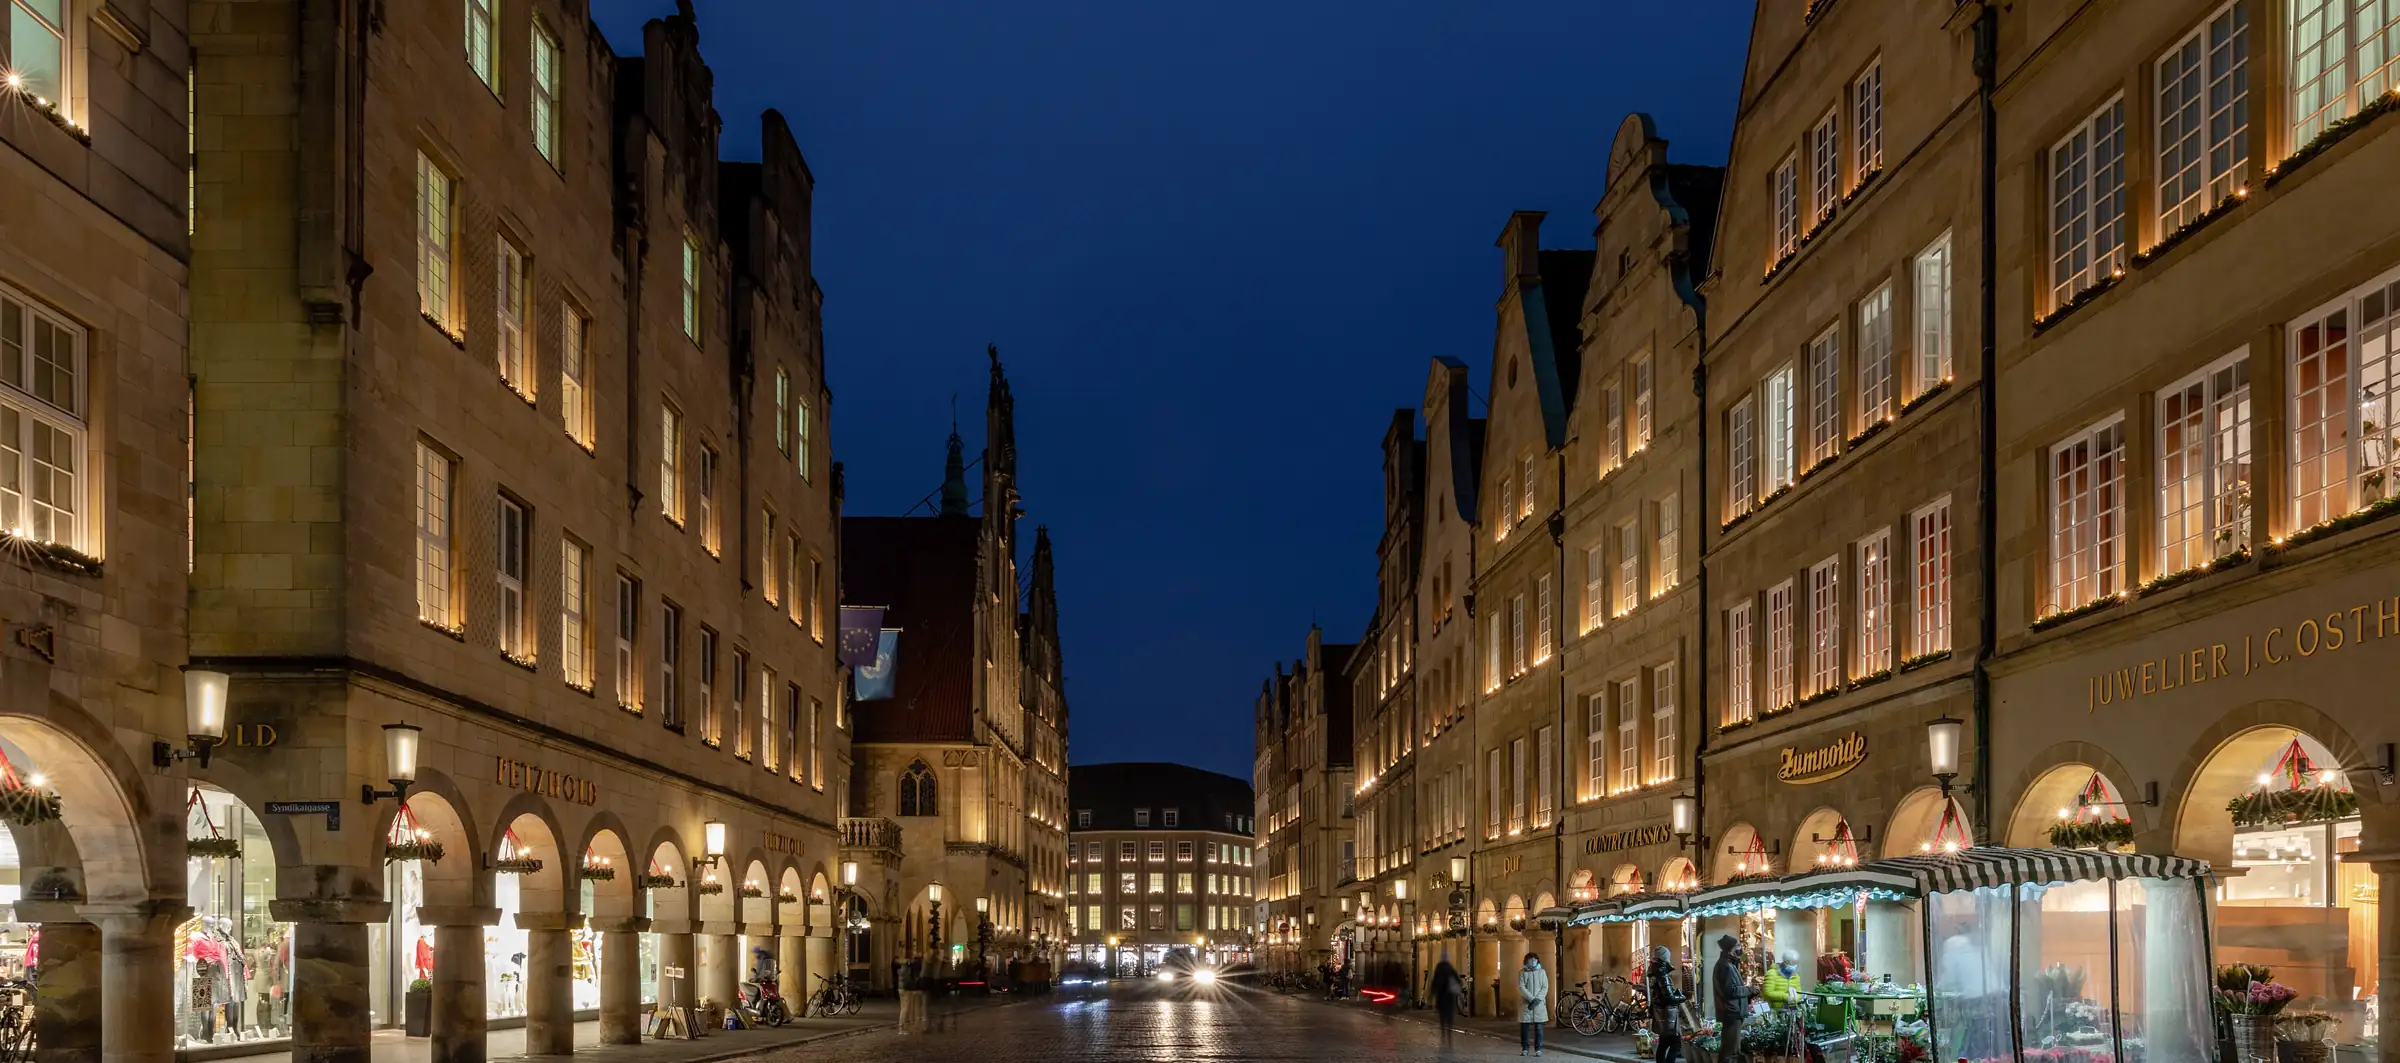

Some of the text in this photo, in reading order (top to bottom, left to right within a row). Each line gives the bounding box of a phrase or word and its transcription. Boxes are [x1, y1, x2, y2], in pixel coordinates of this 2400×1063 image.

[2088, 643, 2229, 714] JUWELIER
[1778, 731, 1866, 780] Zumnorde
[497, 756, 597, 806] PETZHOLD
[1585, 822, 1671, 855] COUNTRY CLASSICS
[1504, 855, 1522, 878] pur
